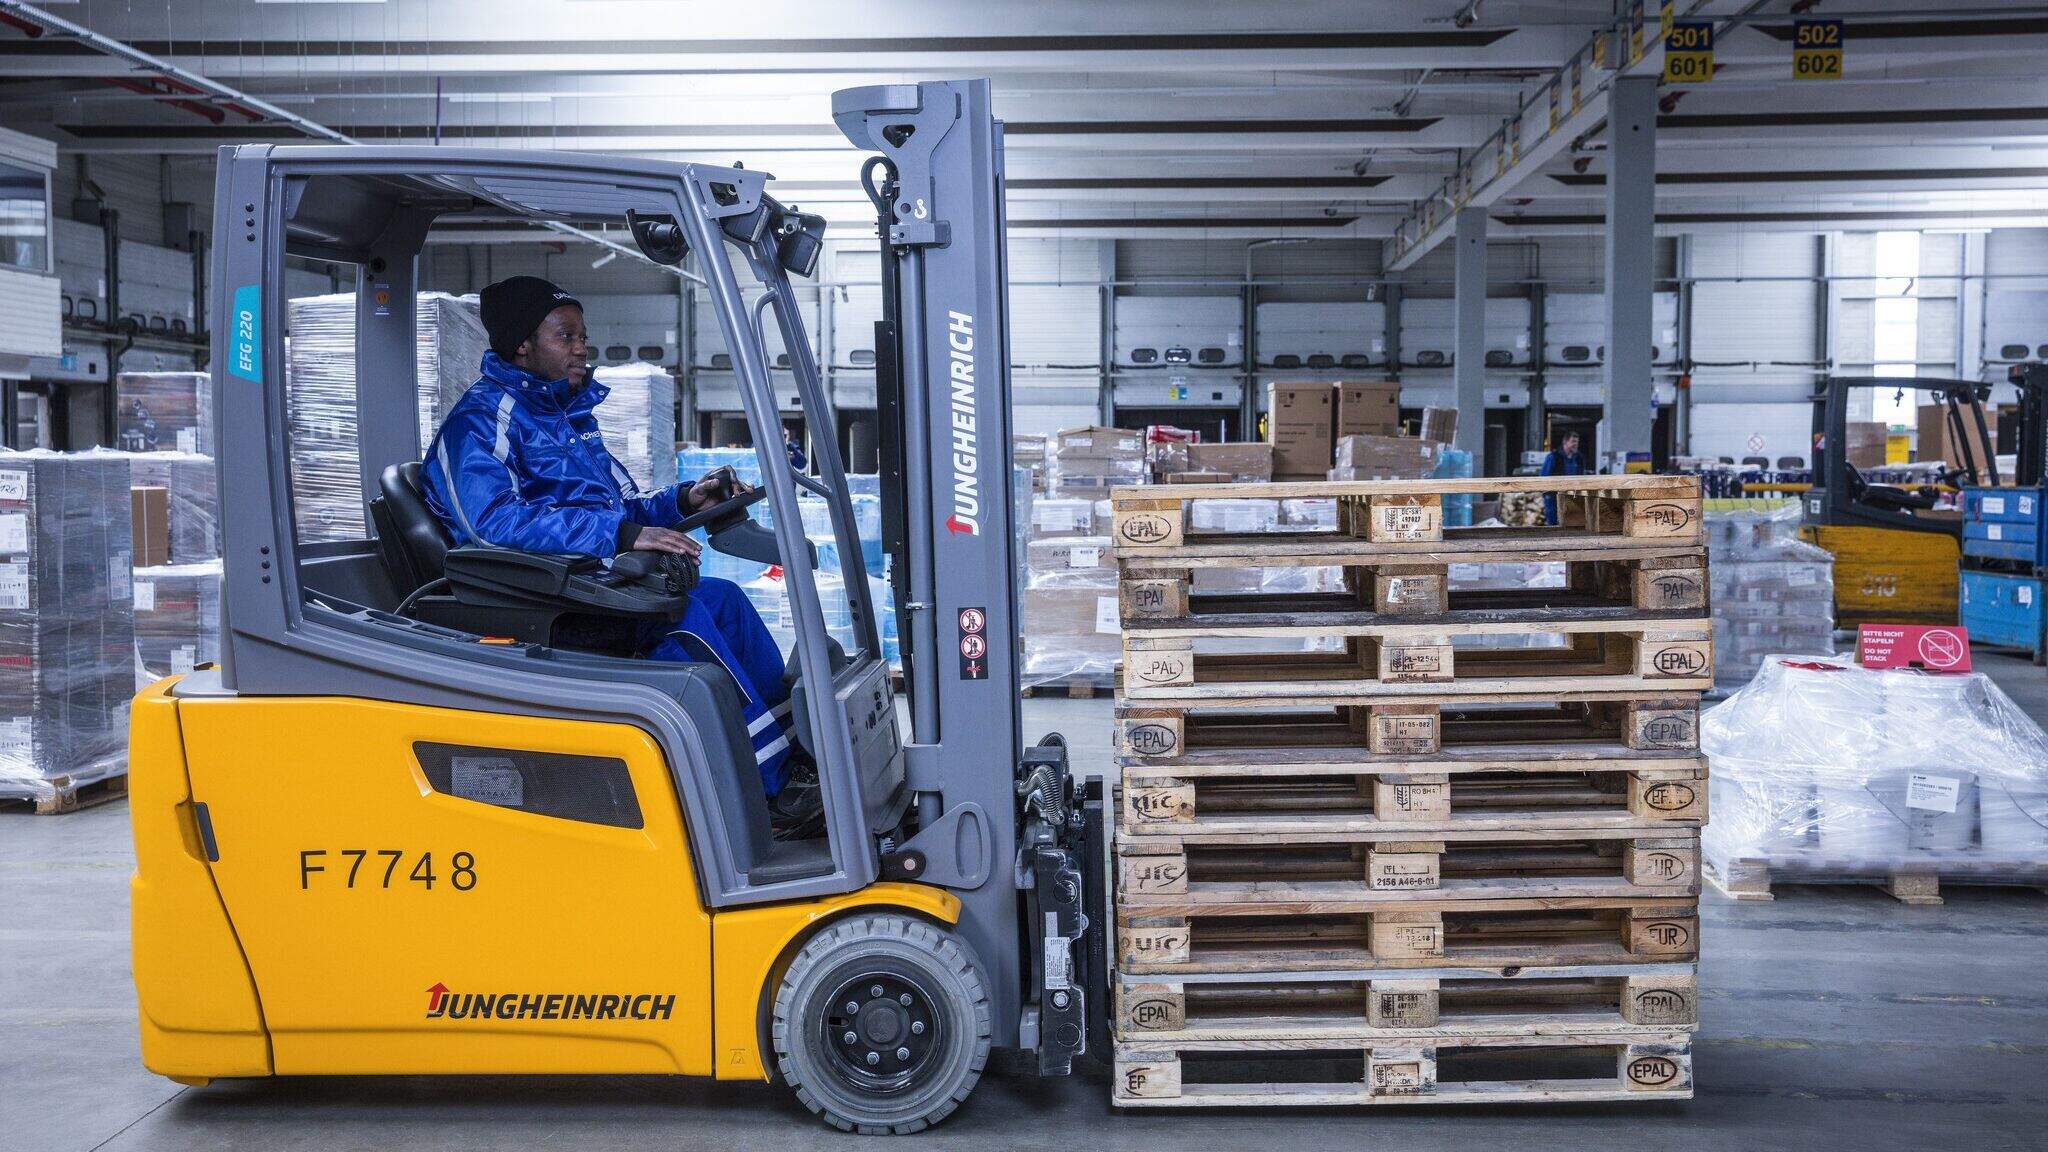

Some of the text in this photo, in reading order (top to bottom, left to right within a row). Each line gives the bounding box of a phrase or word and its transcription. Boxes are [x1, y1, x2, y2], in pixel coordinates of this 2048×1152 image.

[1671, 27, 1710, 48] 501
[1798, 25, 1838, 44] 502
[1670, 57, 1708, 76] 601
[1797, 55, 1838, 73] 602
[240, 310, 253, 372] EFG 220
[948, 310, 980, 536] JUNGHEINRICH
[1661, 654, 1697, 670] EPAL
[1132, 730, 1170, 747] EPAL
[1650, 723, 1687, 740] EPAL
[300, 849, 478, 891] F7748
[427, 991, 675, 1020] JUNGHEINRICH
[1633, 1063, 1669, 1079] EPAL
